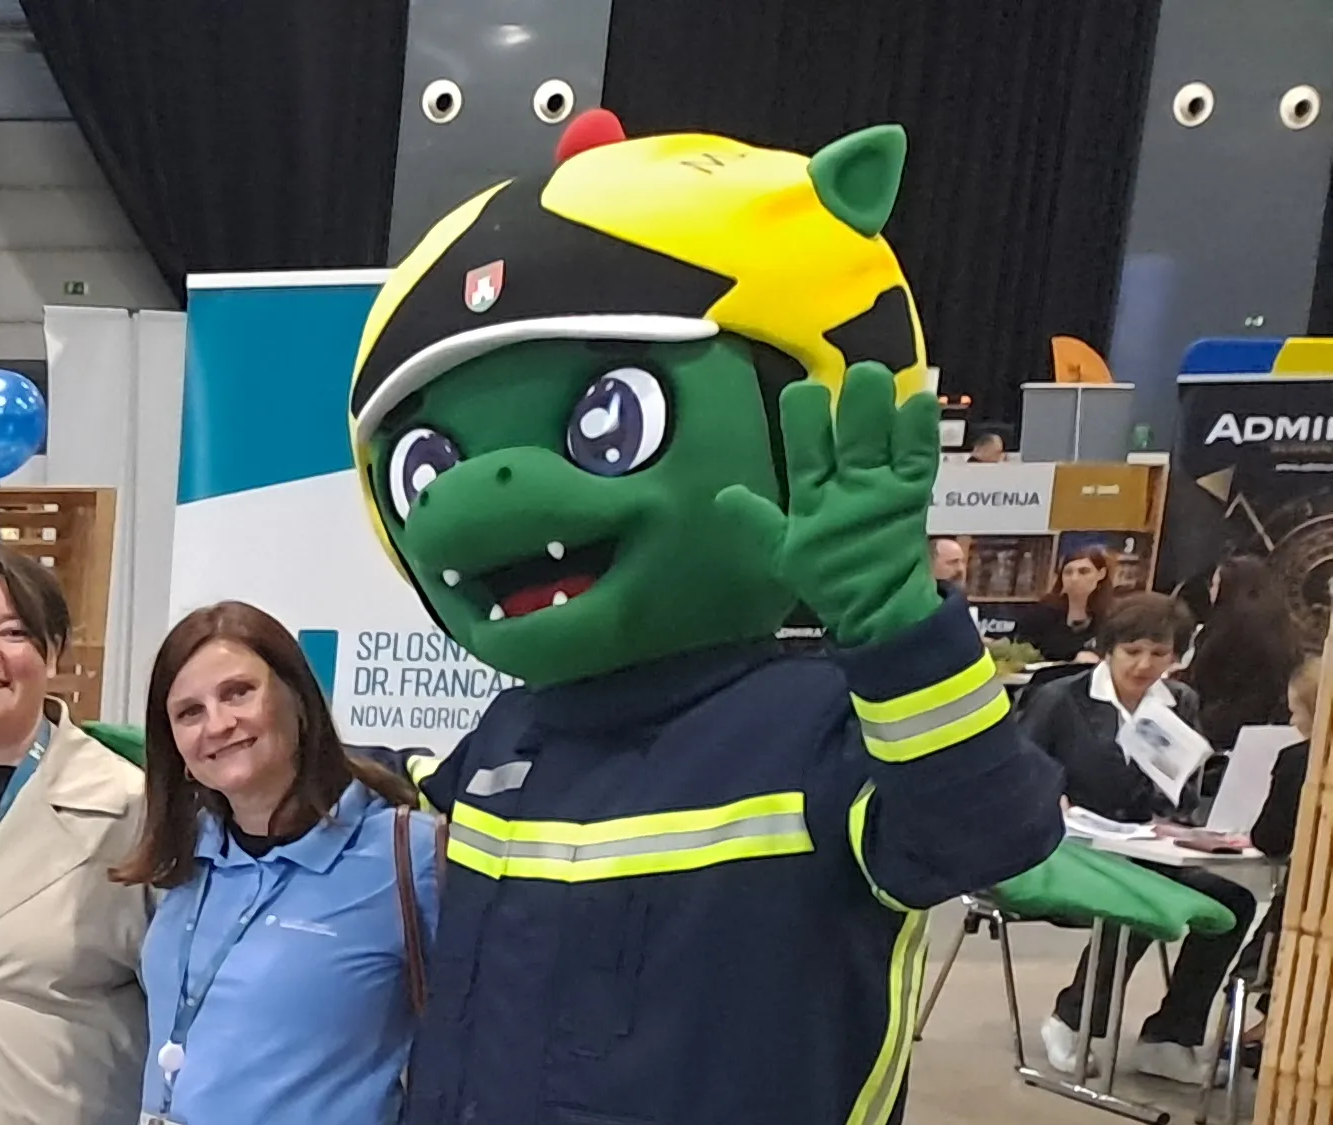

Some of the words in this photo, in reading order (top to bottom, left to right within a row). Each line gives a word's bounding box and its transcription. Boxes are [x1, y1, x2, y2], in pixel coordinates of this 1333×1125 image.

[945, 491, 1041, 507] SLOVENIJA
[354, 667, 393, 697] DR.
[400, 667, 504, 698] FRANCA
[350, 705, 404, 728] NOVA
